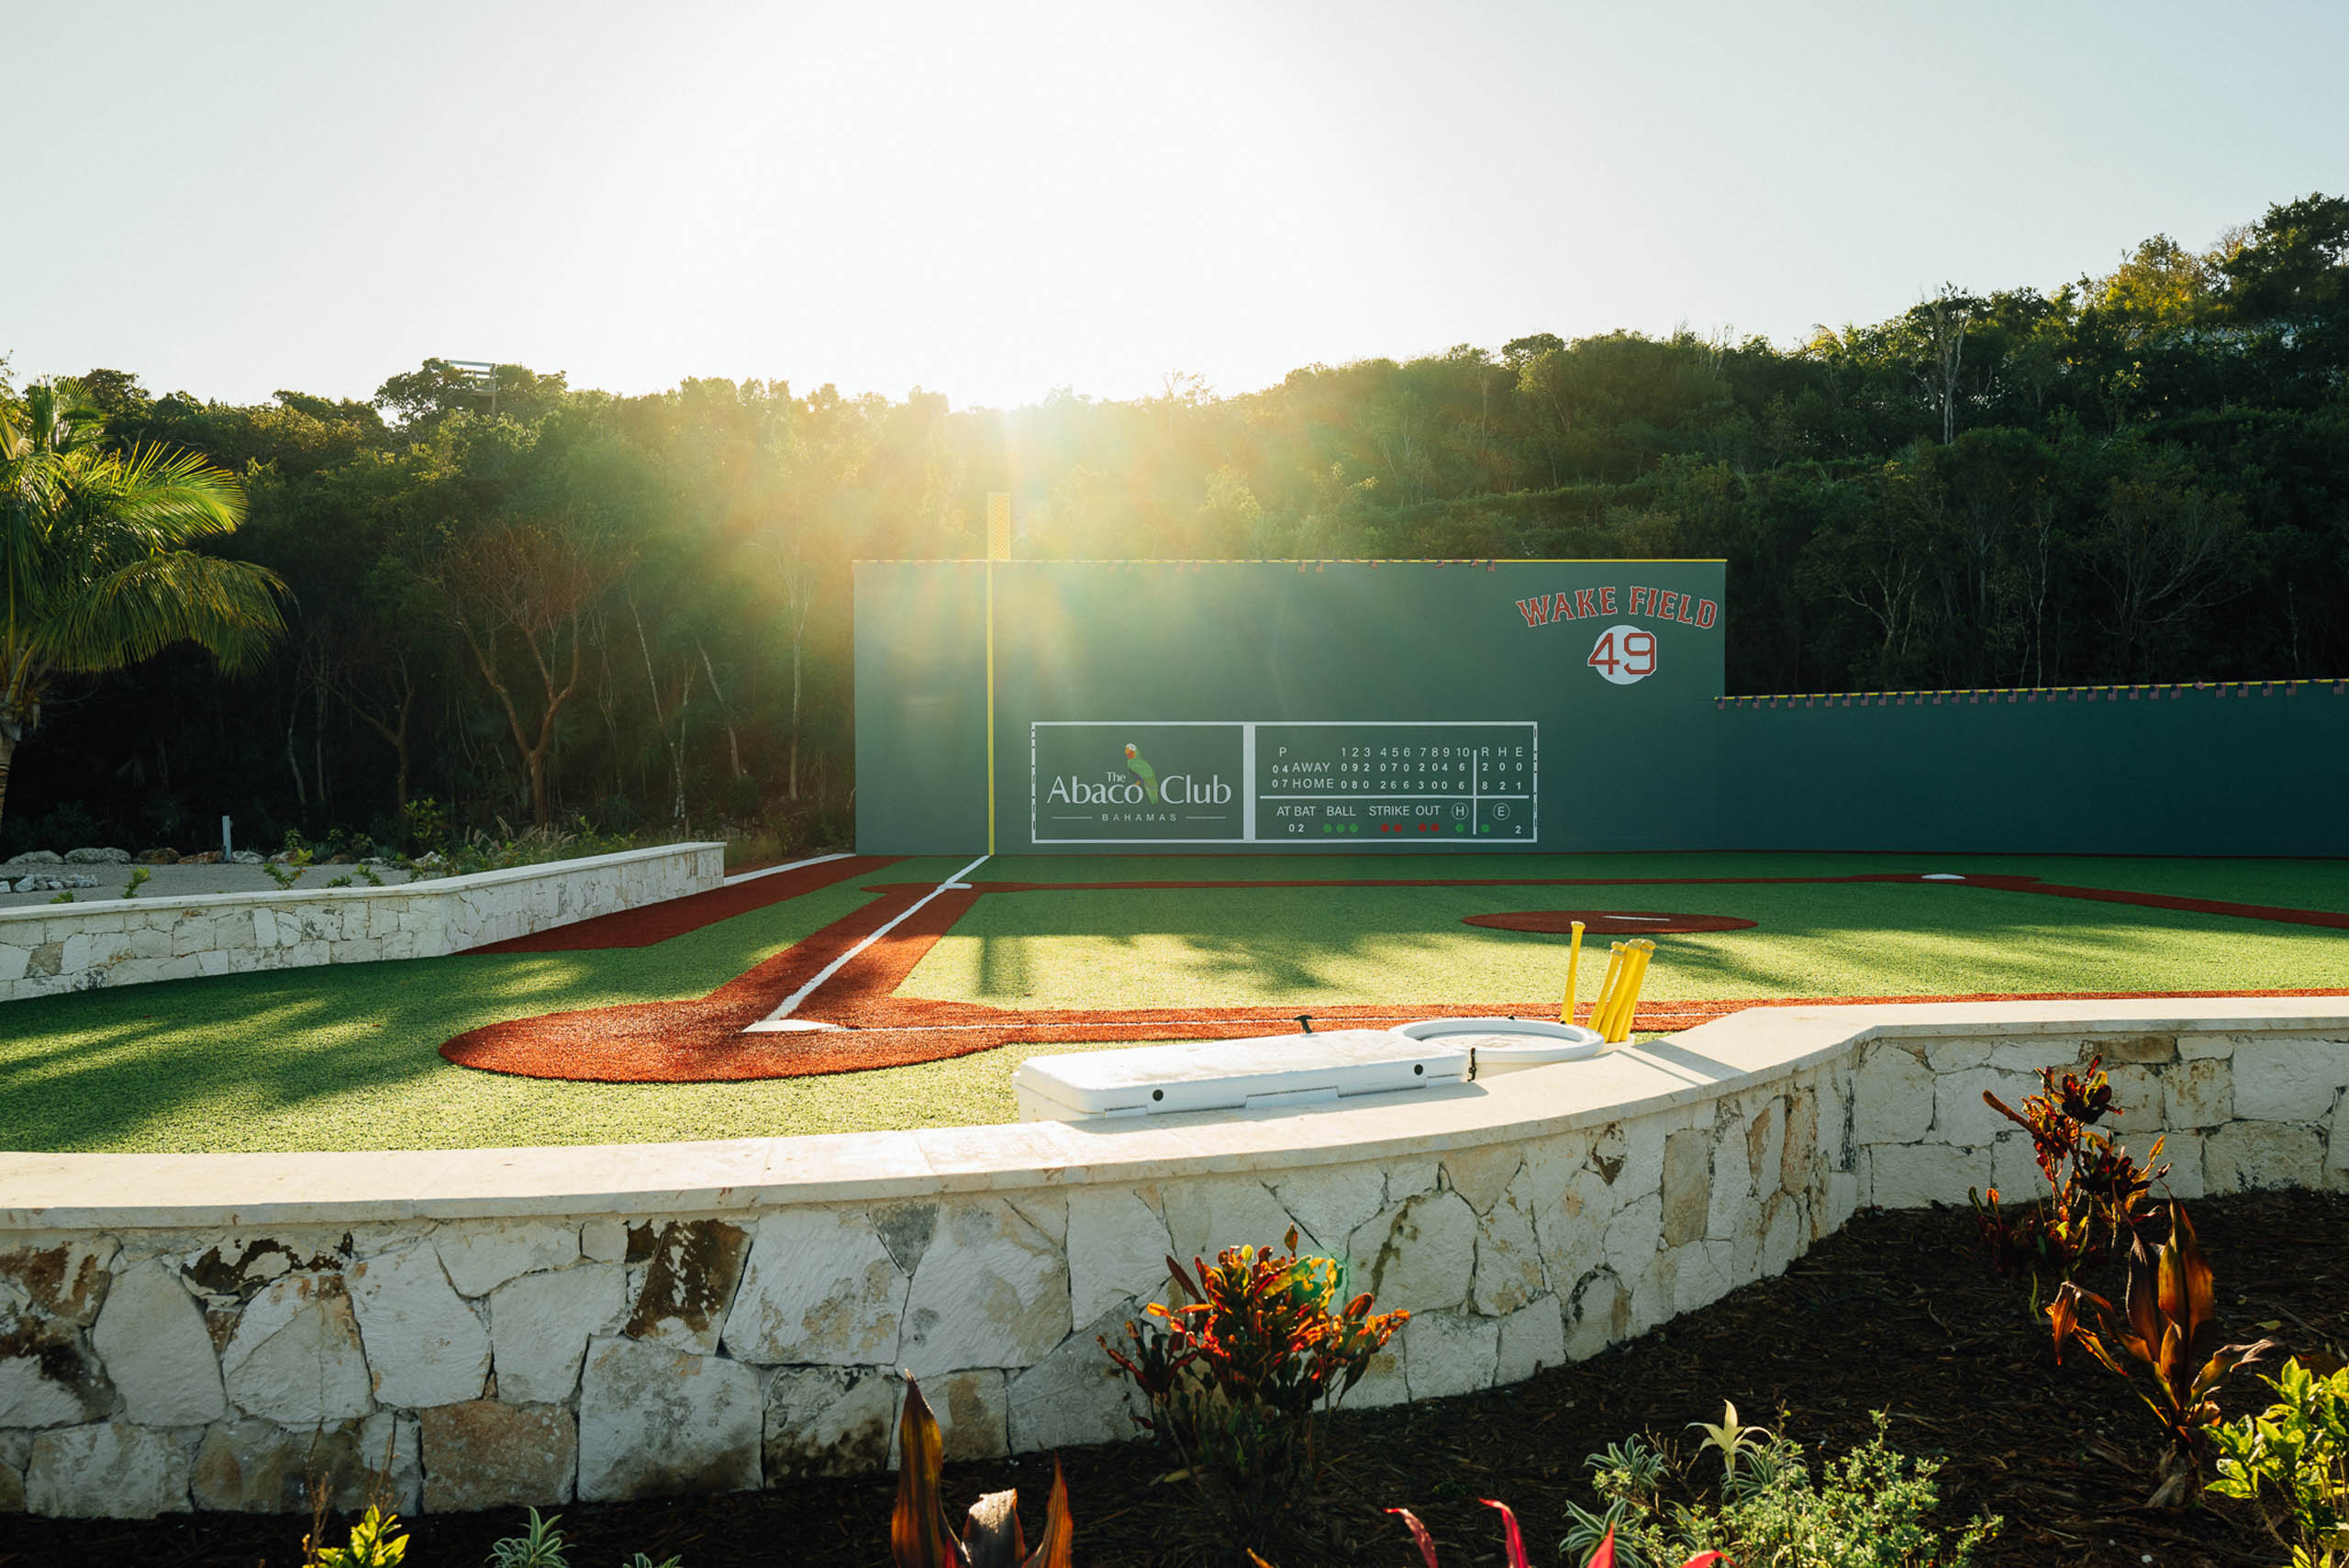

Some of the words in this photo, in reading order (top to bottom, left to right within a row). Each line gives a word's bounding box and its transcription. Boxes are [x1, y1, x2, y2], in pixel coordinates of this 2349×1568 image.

[1516, 586, 1618, 628] WAKE
[1629, 586, 1718, 628] FIELD
[1588, 632, 1656, 676] 49
[1278, 746, 1287, 757] P
[1456, 747, 1470, 757] 10
[1481, 746, 1490, 757] R
[1497, 746, 1508, 757] H
[1515, 746, 1523, 757] E
[1292, 762, 1330, 773] AWAY
[1106, 772, 1126, 783] The
[1047, 775, 1143, 804] Abaco
[1160, 774, 1231, 804] Club
[1292, 778, 1334, 789] HOME
[1276, 806, 1291, 817] AT
[1294, 806, 1317, 817] BAT
[1326, 806, 1356, 817] BALL
[1368, 806, 1410, 817] STRIKE
[1415, 806, 1441, 817] OUT
[1101, 813, 1177, 822] BAHAMAS
[1514, 825, 1522, 835] 2
